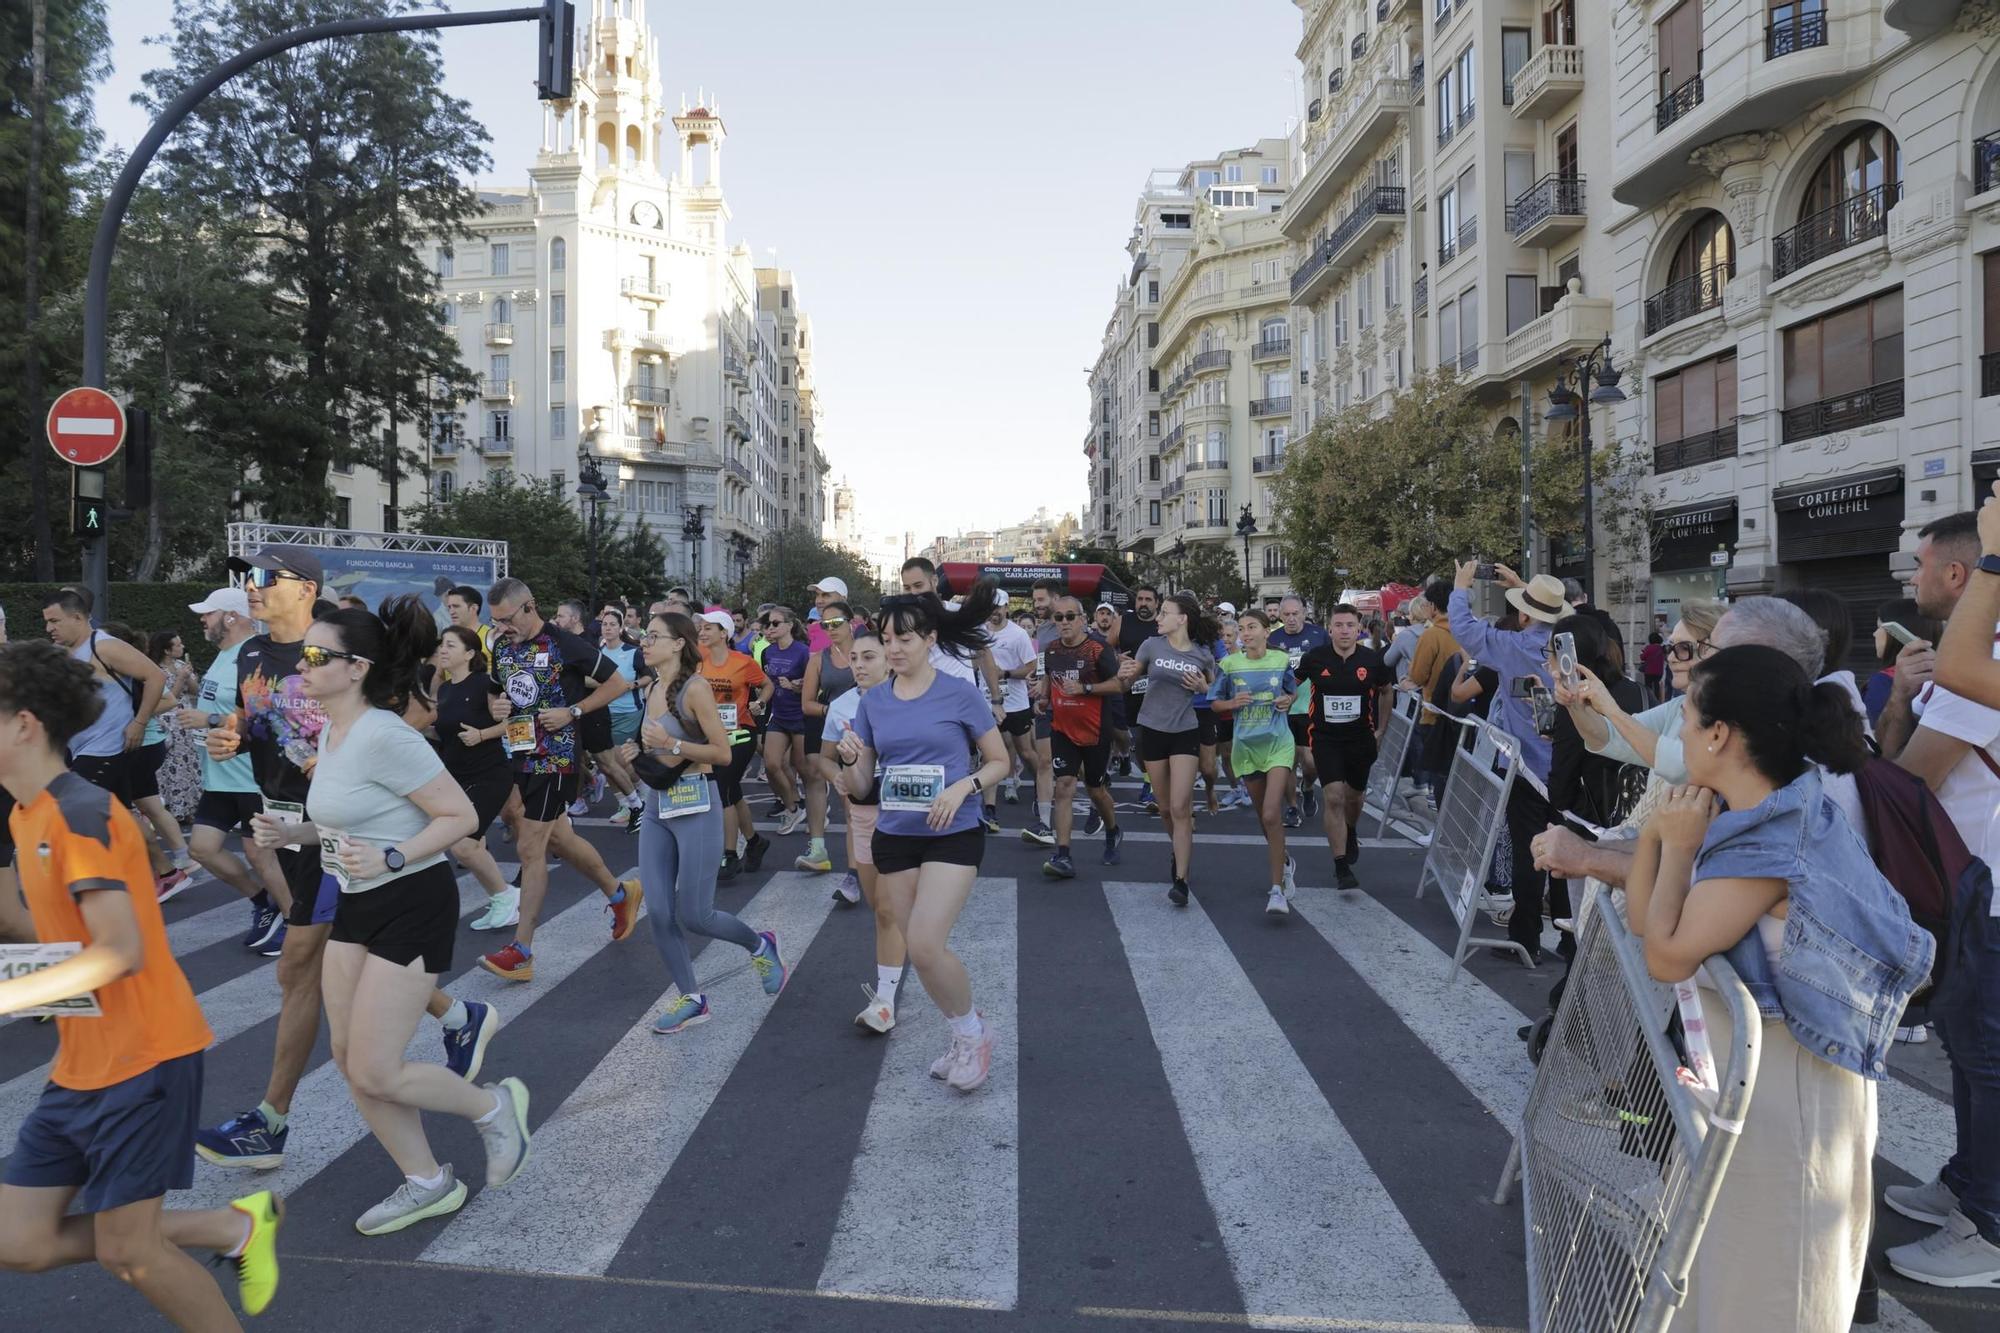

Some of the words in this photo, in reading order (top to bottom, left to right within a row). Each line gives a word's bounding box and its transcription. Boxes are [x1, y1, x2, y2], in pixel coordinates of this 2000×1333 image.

[1799, 483, 1871, 507] CORTEFIEL
[1664, 512, 1713, 529] CORTEFIEL
[346, 559, 384, 568] FUNDACIÓN
[1155, 658, 1198, 673] adidas
[1331, 701, 1353, 711] 912
[891, 783, 932, 797] 1903
